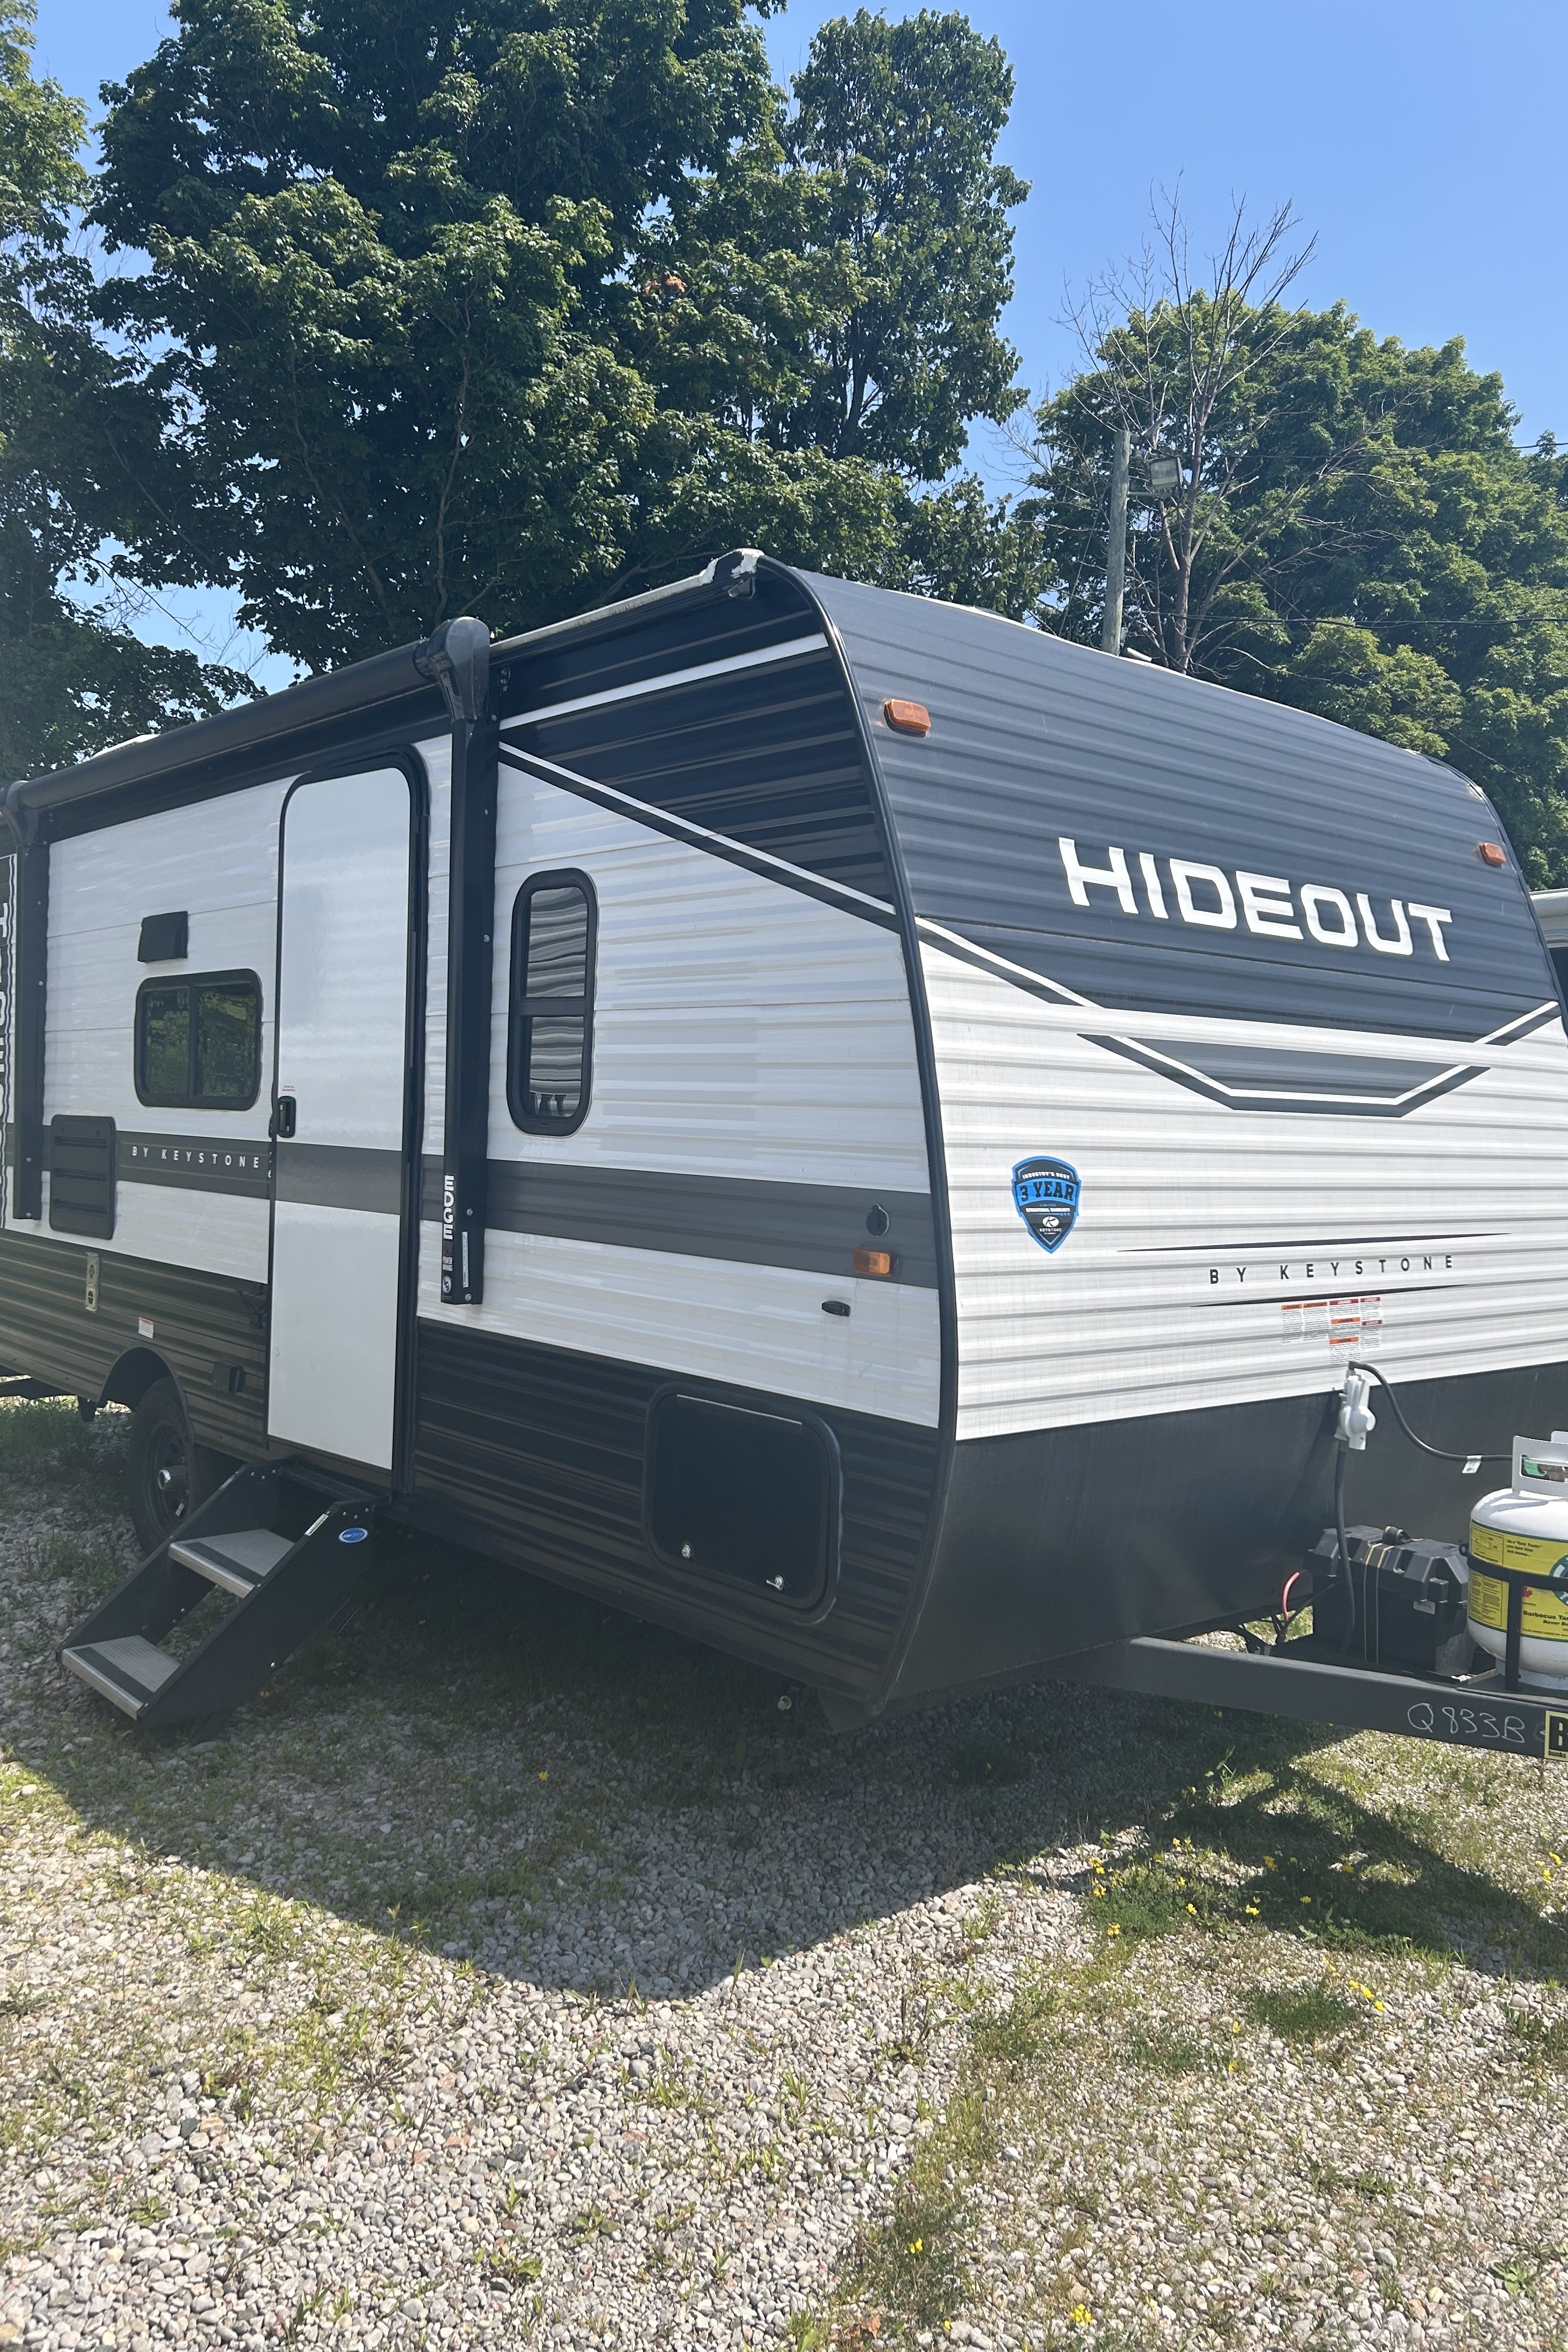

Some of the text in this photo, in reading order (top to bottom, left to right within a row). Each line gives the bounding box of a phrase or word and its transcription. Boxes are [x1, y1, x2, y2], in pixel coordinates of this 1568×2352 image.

[1059, 837, 1452, 961] HIDEOUT
[132, 1146, 259, 1168] BY KEYSTONE
[1020, 1181, 1074, 1201] 3 YEAR
[443, 1175, 454, 1240] EDGE
[1210, 1255, 1452, 1284] BY KEYSTONE
[1523, 1611, 1556, 1619] Barbecue
